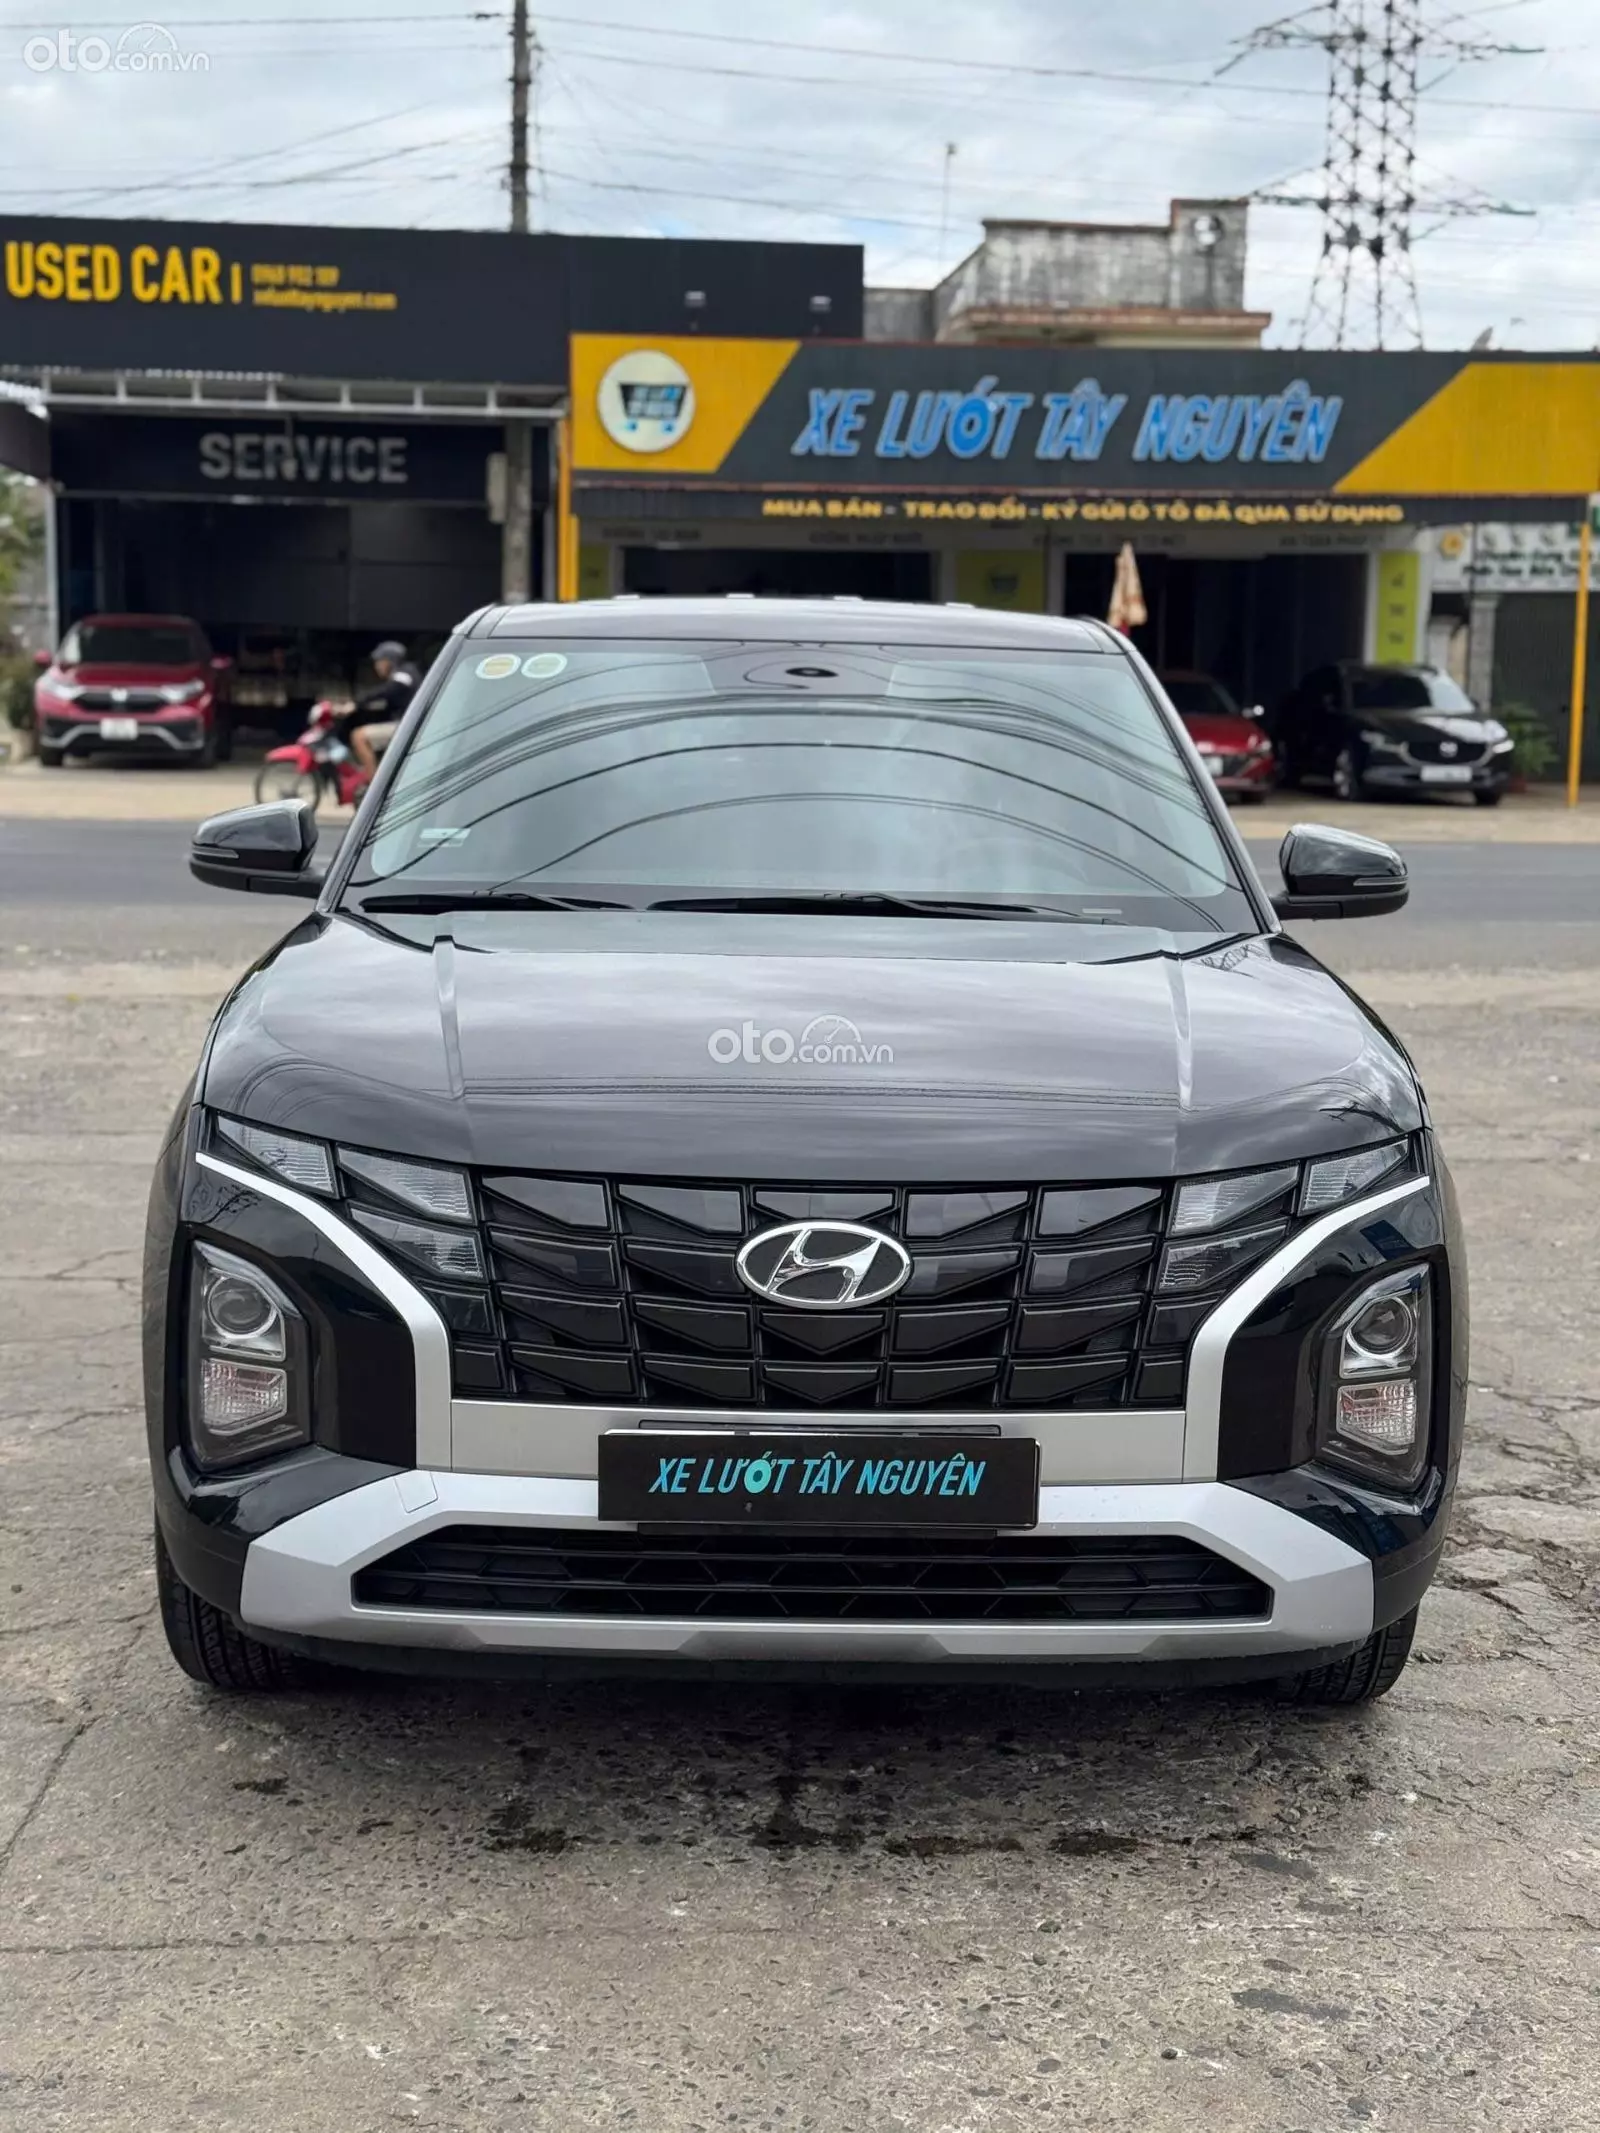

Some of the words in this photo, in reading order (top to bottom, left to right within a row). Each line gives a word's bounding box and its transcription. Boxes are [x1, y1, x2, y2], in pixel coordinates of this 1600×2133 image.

[6, 242, 121, 301] USED
[131, 246, 223, 304] CAR
[792, 388, 872, 456] XE
[875, 377, 1033, 458] LƯỚT
[1036, 379, 1128, 461] TÂY
[1132, 380, 1343, 463] NGUYÊN
[200, 432, 409, 483] SERVICE
[762, 499, 823, 517] MUA
[826, 497, 881, 518] BÁN
[903, 501, 976, 519] TRAO
[1042, 499, 1078, 521] KÝ
[1153, 499, 1190, 521] TÔ
[1234, 504, 1290, 524] QUA
[1331, 504, 1404, 525] DỤNG
[648, 1457, 695, 1494] XE
[698, 1450, 796, 1494] LƯỚT
[798, 1451, 852, 1494] TÂY
[855, 1453, 987, 1496] NGUYÊN
